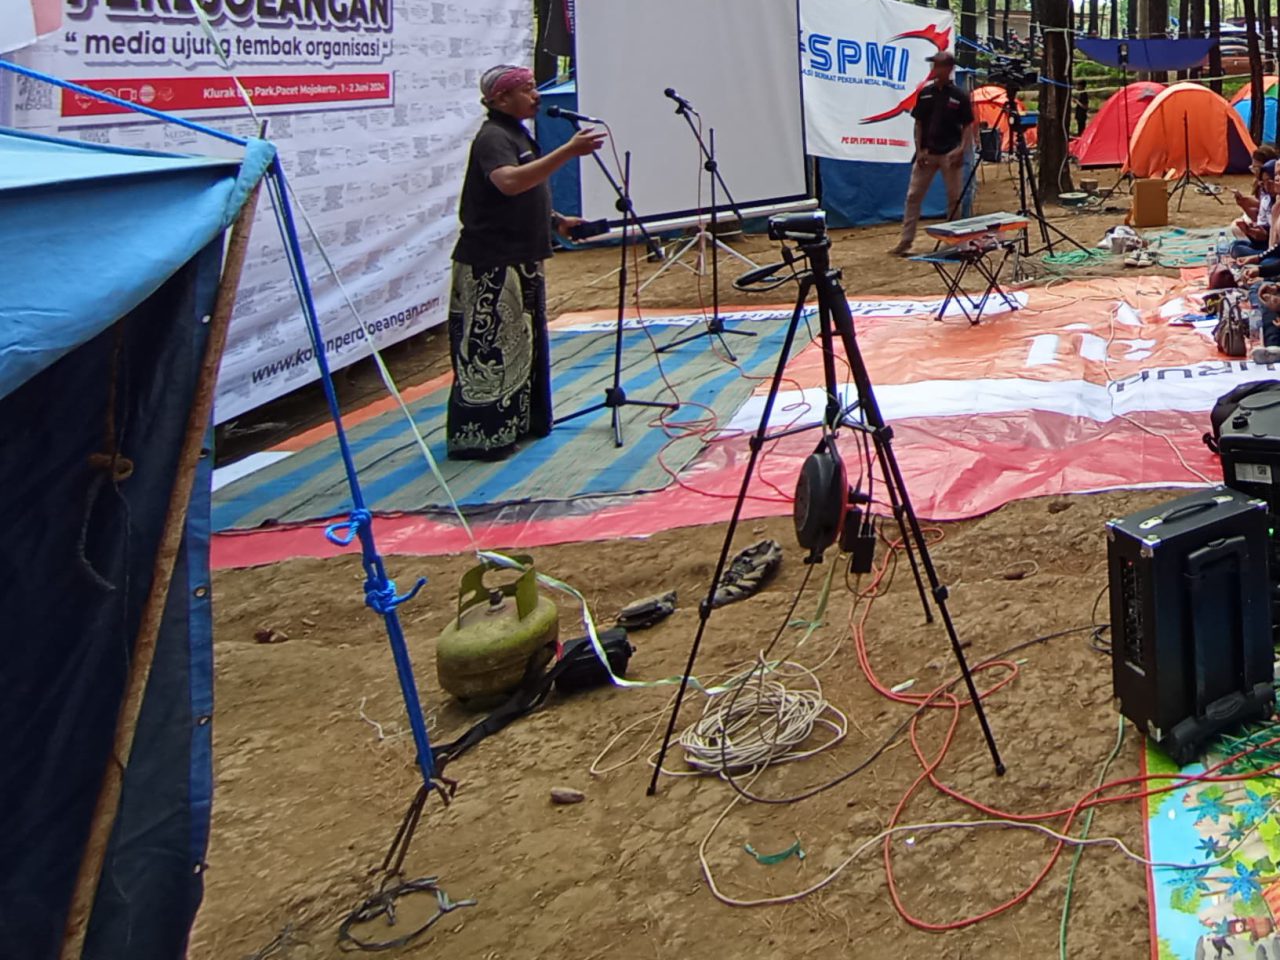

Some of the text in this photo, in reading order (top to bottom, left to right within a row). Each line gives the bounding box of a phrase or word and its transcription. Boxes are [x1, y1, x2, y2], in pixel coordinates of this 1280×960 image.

[85, 31, 166, 56] media
[236, 35, 302, 57] tembak
[305, 37, 380, 60] organisasi
[800, 29, 910, 83] SPMI
